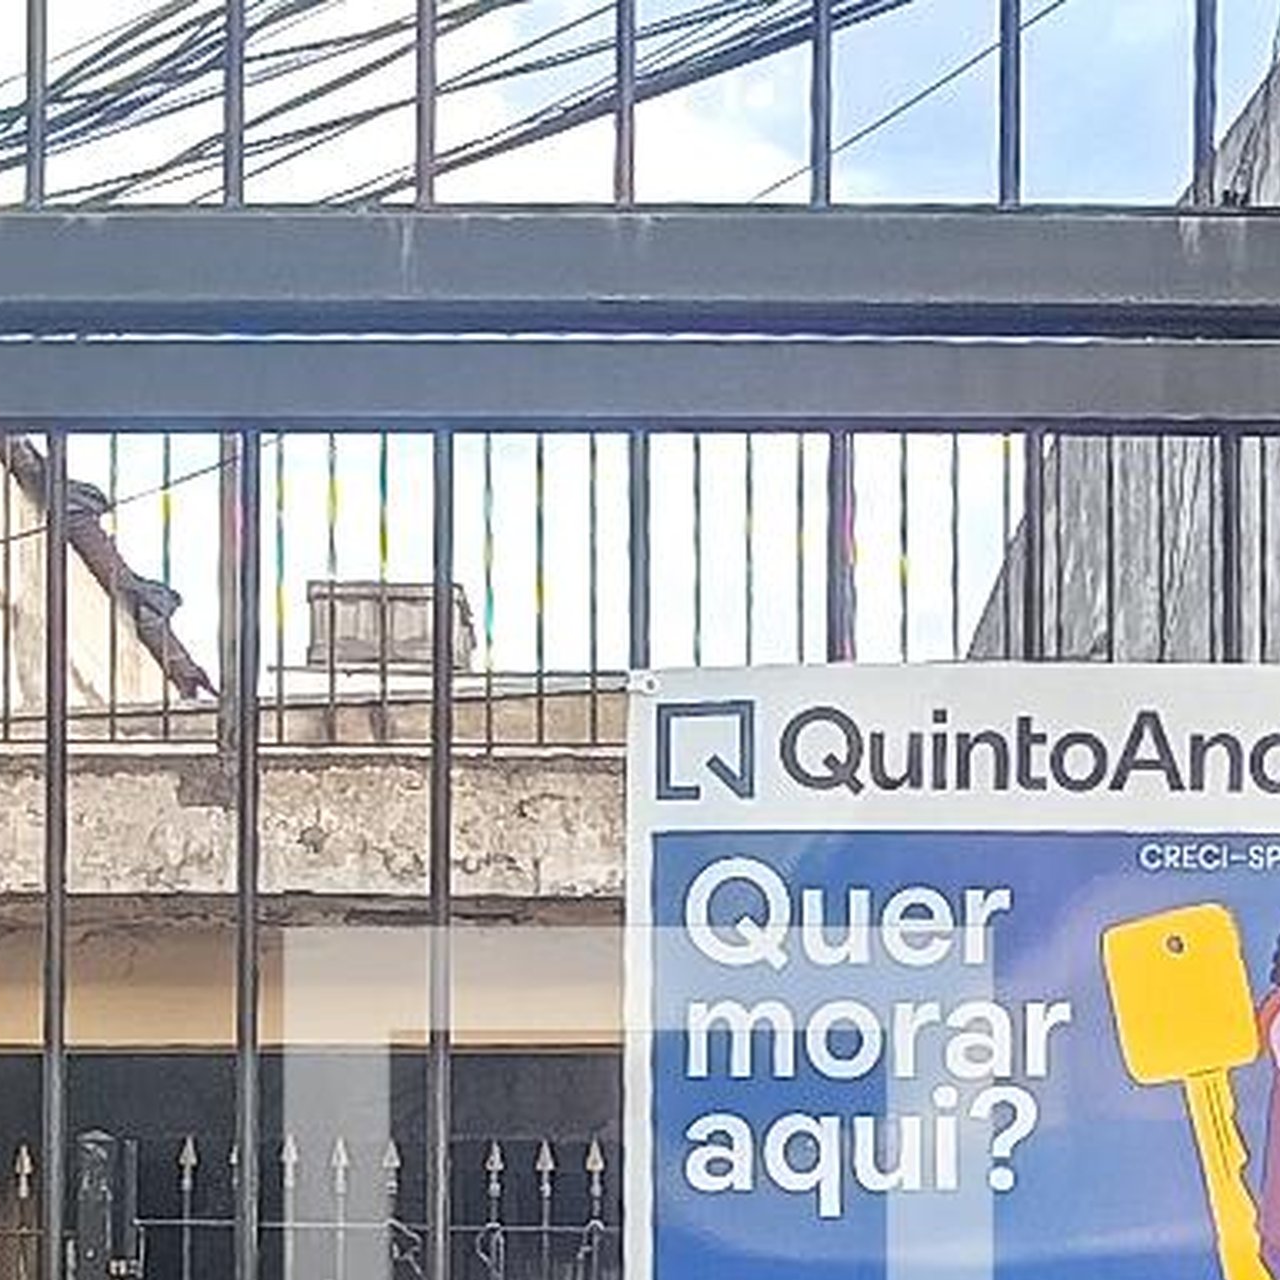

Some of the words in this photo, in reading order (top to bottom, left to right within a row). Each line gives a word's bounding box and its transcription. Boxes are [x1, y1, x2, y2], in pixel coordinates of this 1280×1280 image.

[684, 857, 1011, 971] Quer
[685, 1000, 1071, 1078] morar
[684, 1086, 1039, 1217] aqui?
